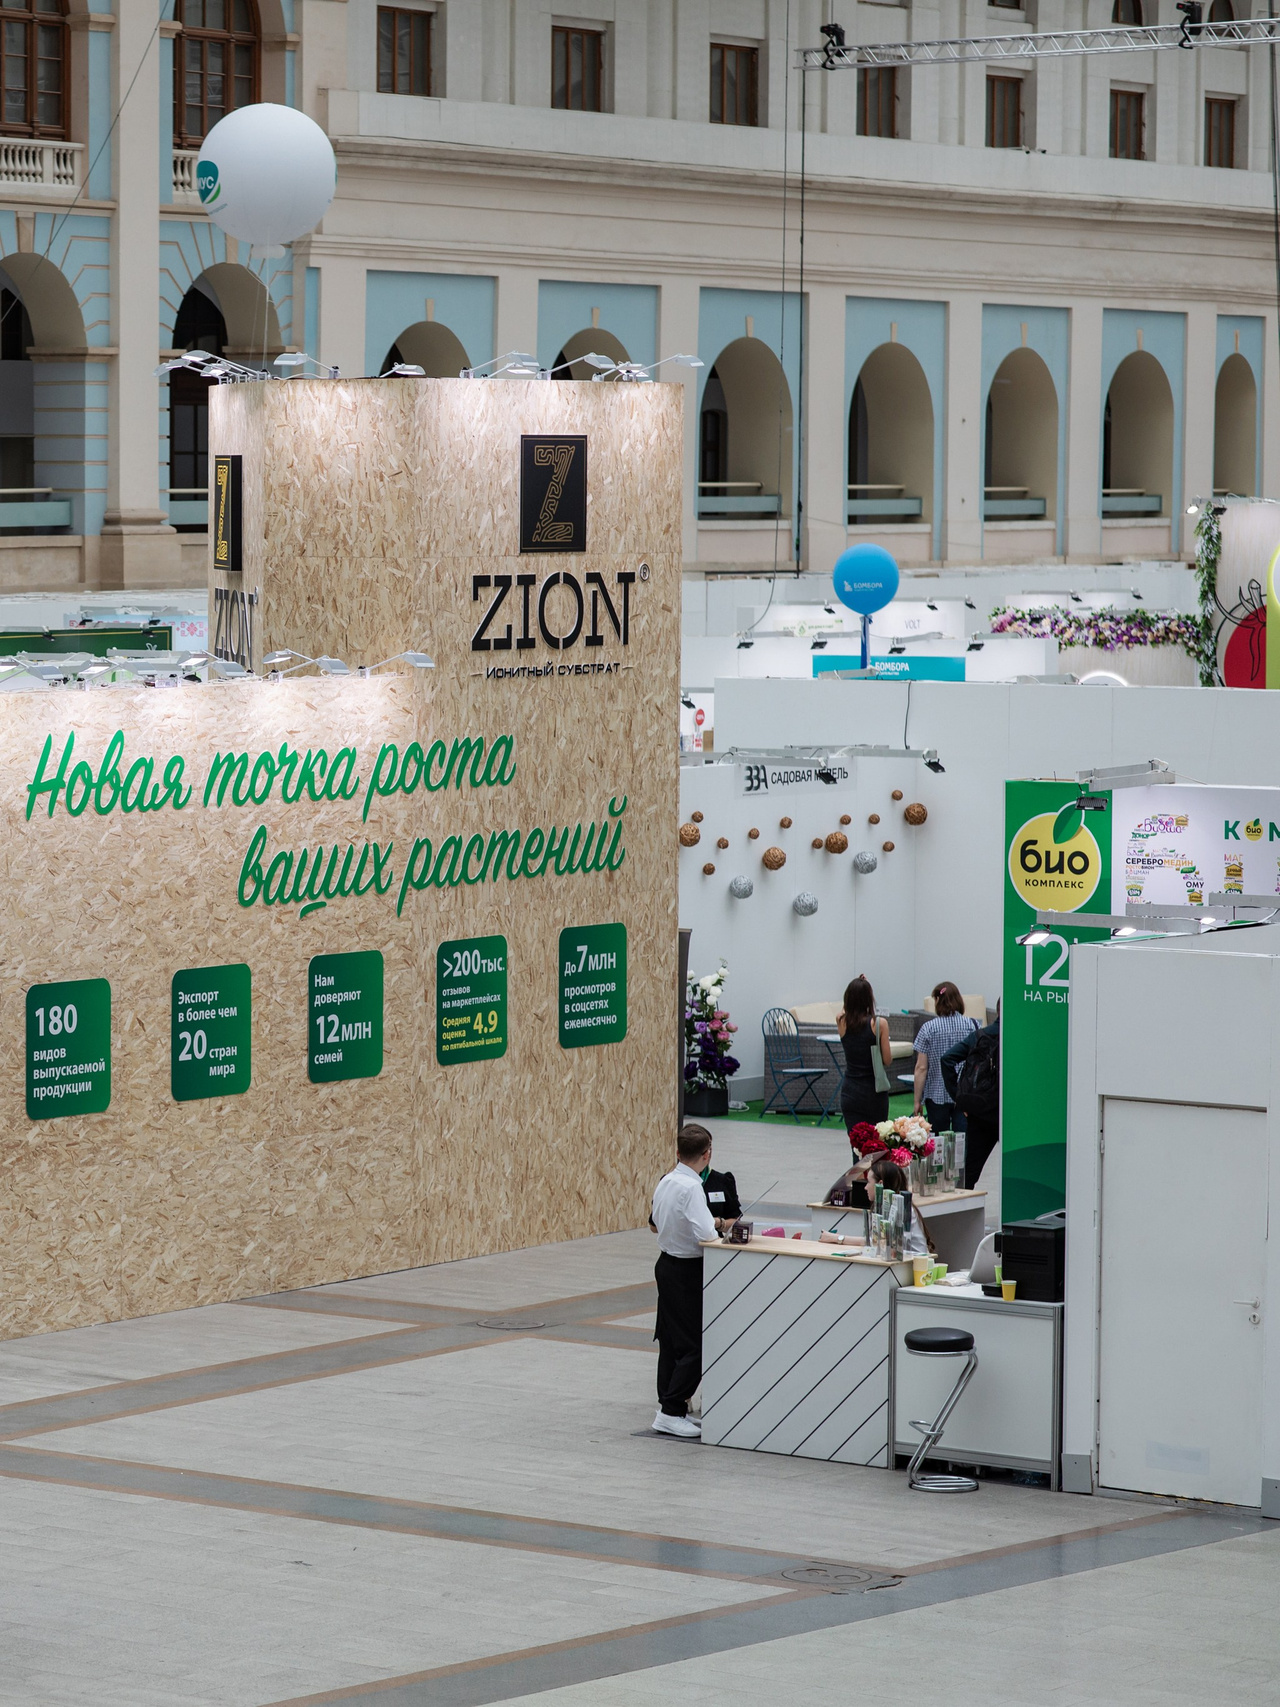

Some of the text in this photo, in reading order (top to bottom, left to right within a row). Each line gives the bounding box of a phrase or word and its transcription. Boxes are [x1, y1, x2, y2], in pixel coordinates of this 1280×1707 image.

[471, 571, 635, 651] ZION
[215, 587, 254, 669] ZION
[905, 619, 921, 630] VOLT
[25, 729, 517, 823] Новая точка роста
[771, 769, 812, 786] САДОВАЯ
[237, 795, 628, 919] ваших растений
[1020, 839, 1090, 875] био
[1125, 857, 1193, 867] СЕРЕБРОМЕДИН
[1025, 878, 1084, 889] КОМПЛЕКС
[564, 961, 576, 977] До
[576, 944, 588, 973] 7
[314, 974, 335, 987] Нам
[178, 990, 219, 1005] Экспорт
[314, 990, 361, 1007] доверяют
[442, 985, 471, 997] отзывов
[564, 982, 616, 1000] просмотров
[1024, 990, 1043, 1003] НА
[442, 993, 501, 1009] на маркетплейсах
[564, 999, 609, 1014] в соцсетях
[34, 1003, 78, 1037] 180
[178, 1006, 238, 1022] в более чем
[442, 1010, 498, 1034] Средняя 4.9
[564, 1014, 618, 1030] ежемесячно
[316, 1013, 340, 1044] 12
[442, 1029, 466, 1041] оценка
[178, 1030, 238, 1062] 20 стран
[442, 1043, 450, 1051] по
[485, 1036, 503, 1045] шкале
[33, 1047, 66, 1062] видов
[314, 1048, 343, 1065] семей
[33, 1058, 106, 1080] выпускаемой
[209, 1063, 236, 1078] мира
[33, 1080, 92, 1101] продукции
